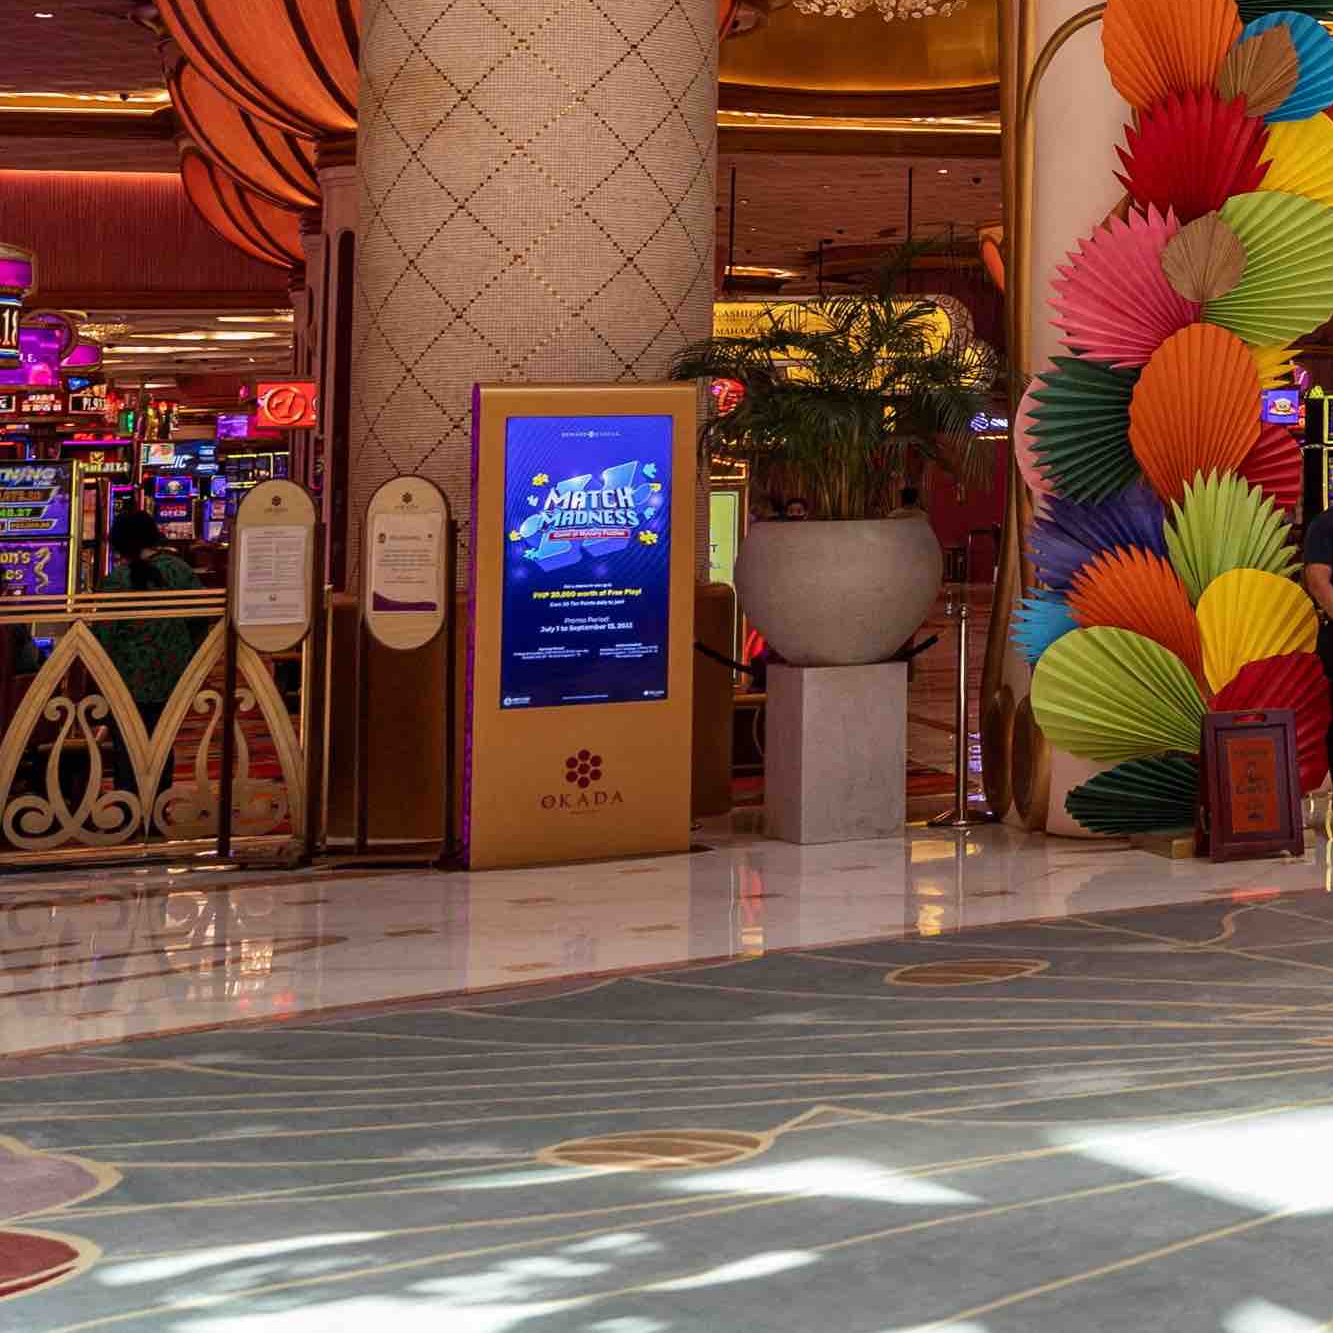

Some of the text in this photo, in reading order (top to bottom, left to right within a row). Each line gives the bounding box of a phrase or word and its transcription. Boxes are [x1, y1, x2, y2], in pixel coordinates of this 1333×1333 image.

[544, 487, 634, 510] MATCH
[541, 509, 639, 527] MADNESS
[541, 791, 623, 809] OKADA
